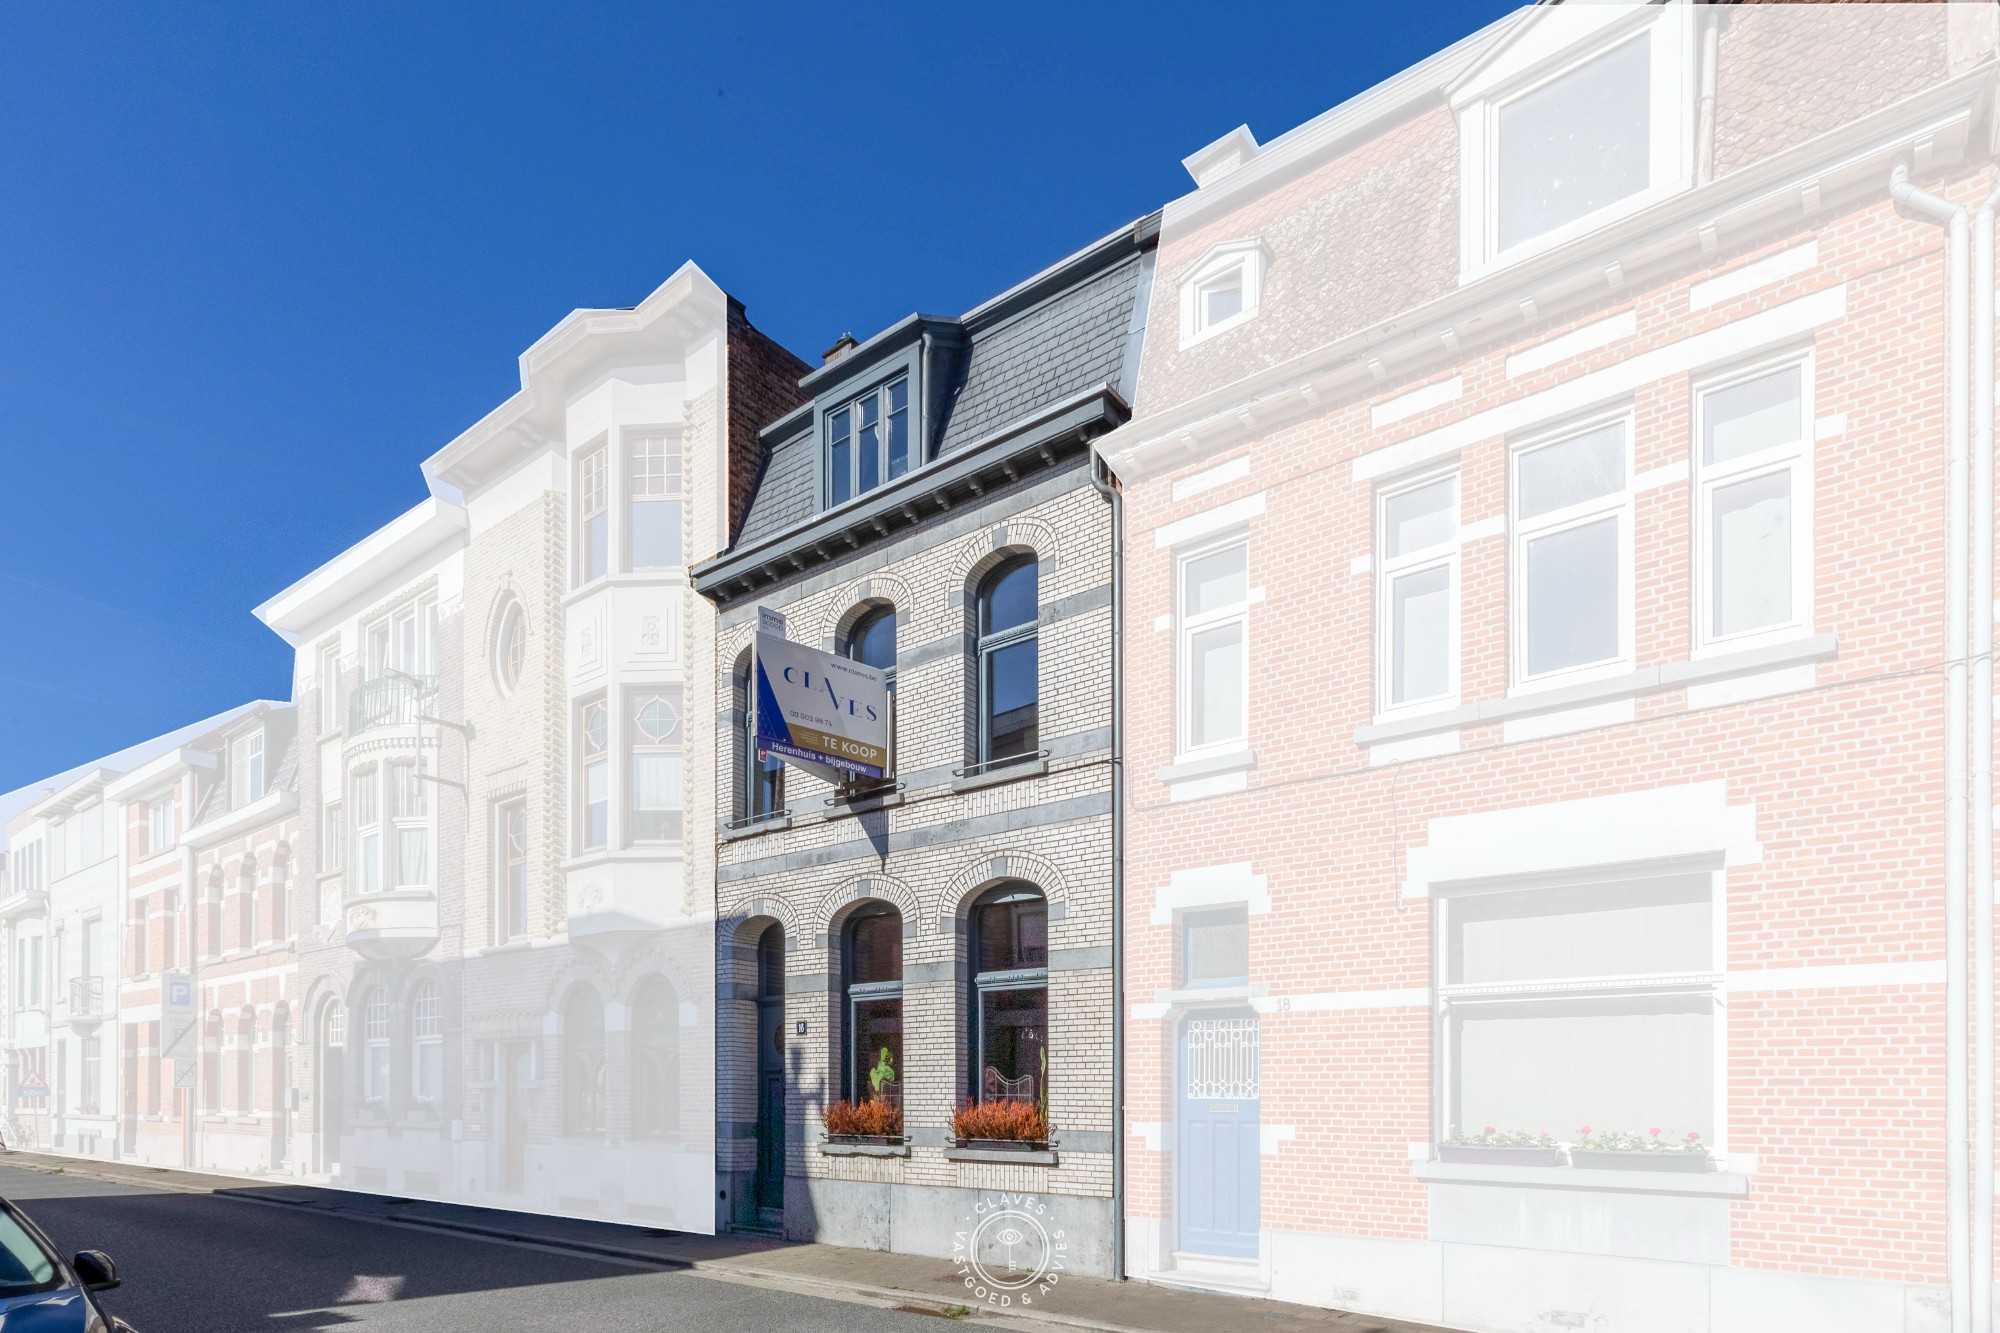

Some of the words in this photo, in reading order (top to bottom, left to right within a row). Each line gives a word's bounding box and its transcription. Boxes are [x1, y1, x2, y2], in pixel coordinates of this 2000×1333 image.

[761, 610, 784, 624] immo
[761, 619, 784, 631] scoop
[830, 663, 877, 681] www.claves.be
[783, 666, 877, 722] CLAVES
[789, 710, 799, 718] 03
[800, 713, 814, 722] 502
[814, 717, 824, 725] 98
[822, 736, 838, 750] TE
[842, 741, 878, 759] KOOP
[772, 741, 816, 760] Herenhuis
[825, 755, 867, 773] bijgebouw
[1276, 997, 1291, 1011] 18
[798, 1022, 804, 1033] 16
